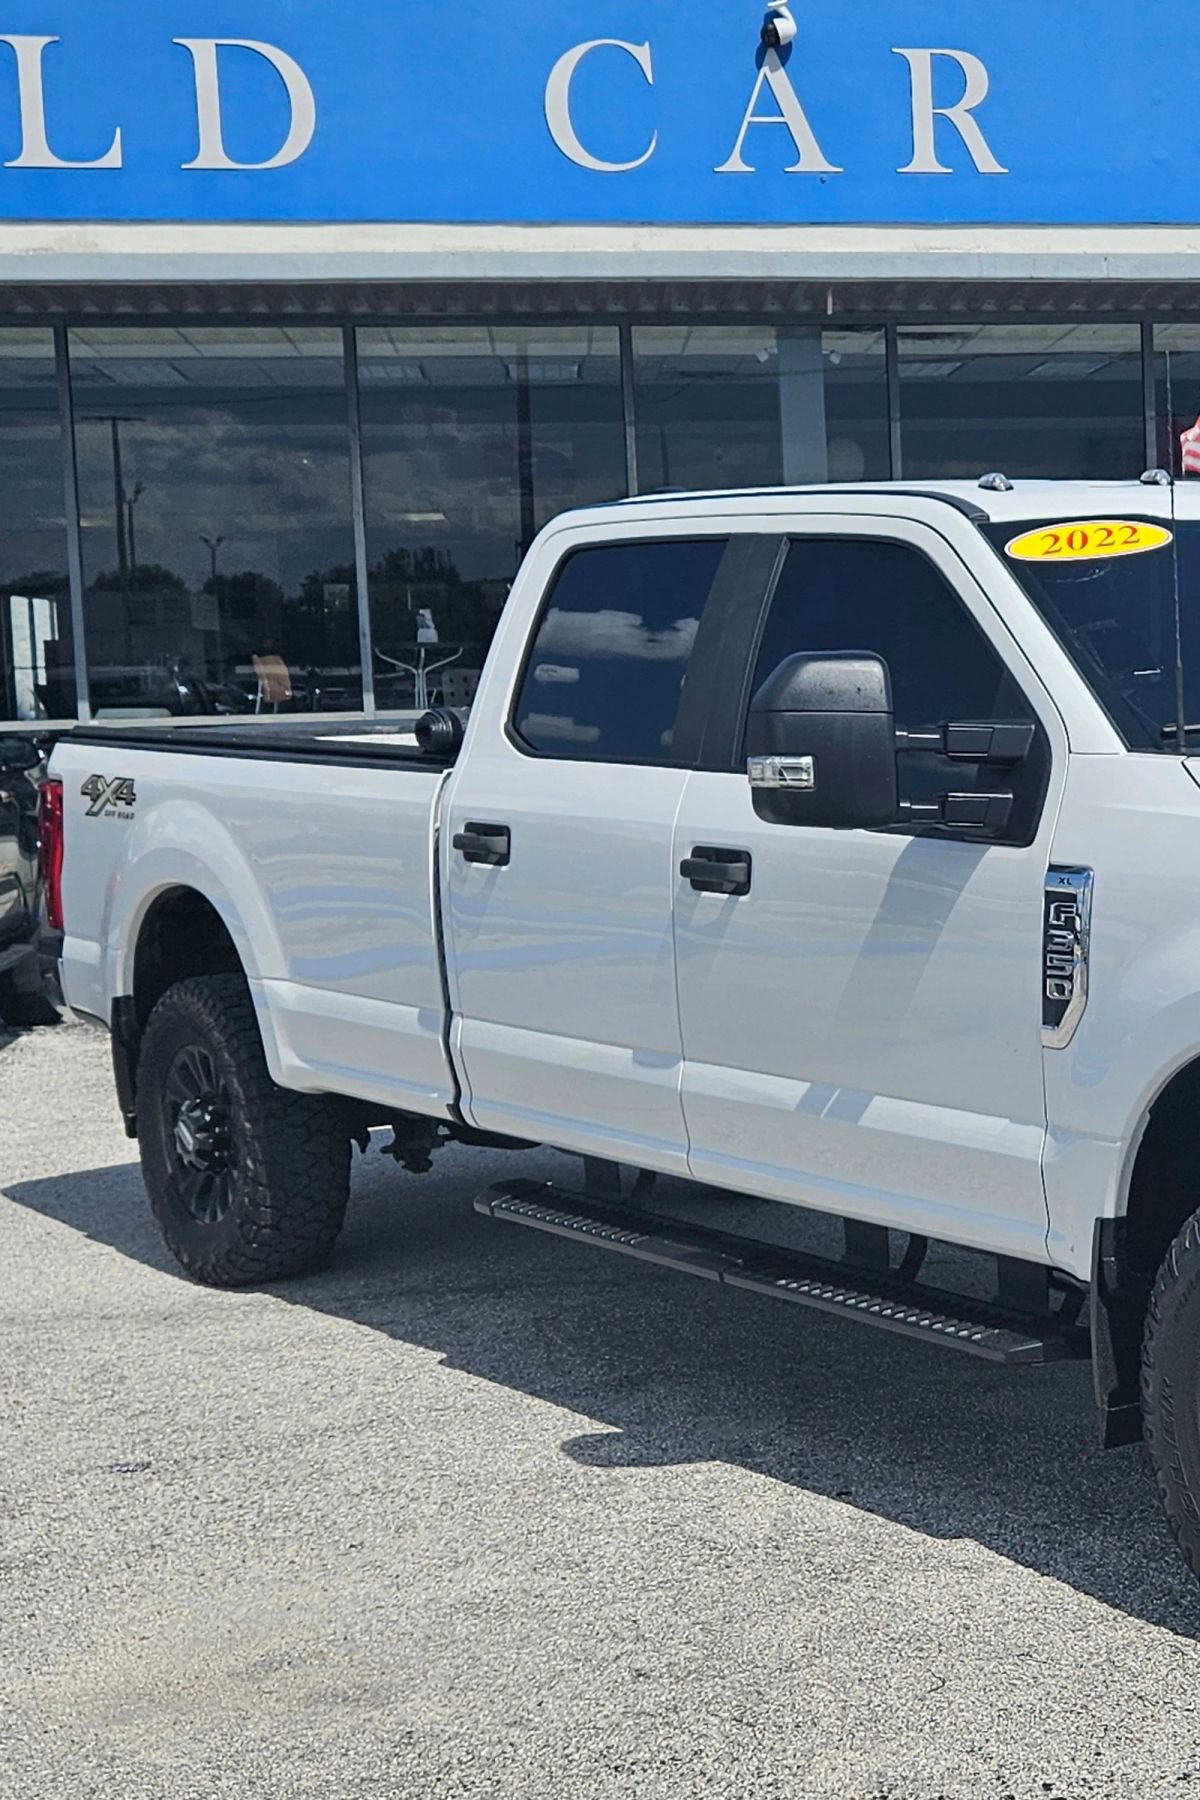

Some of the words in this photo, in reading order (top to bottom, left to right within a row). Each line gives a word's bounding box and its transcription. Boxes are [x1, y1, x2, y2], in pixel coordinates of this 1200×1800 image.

[0, 35, 317, 171] LD
[544, 38, 1009, 173] CAR
[1041, 525, 1141, 556] 2022
[1058, 876, 1073, 886] XL
